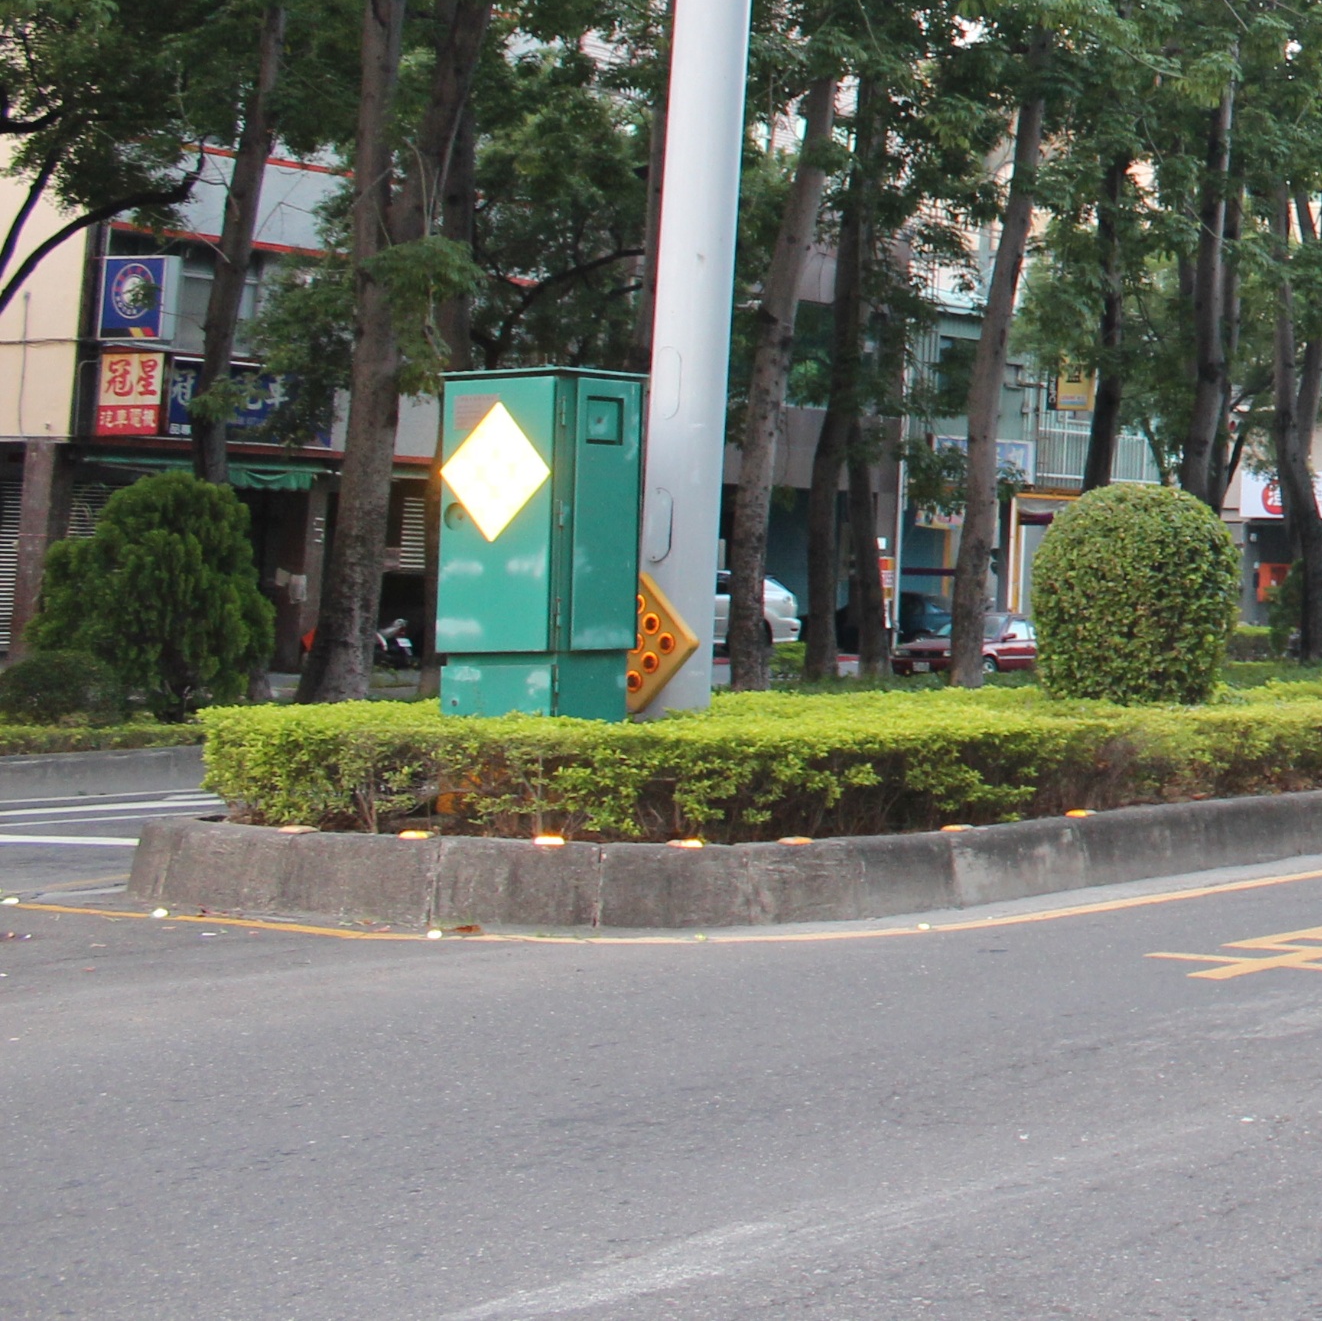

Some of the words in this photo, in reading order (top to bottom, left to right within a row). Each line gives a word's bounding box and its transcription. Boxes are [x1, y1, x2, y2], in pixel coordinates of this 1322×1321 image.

[104, 358, 159, 398] 冠星
[99, 408, 158, 429] 汽車電機
